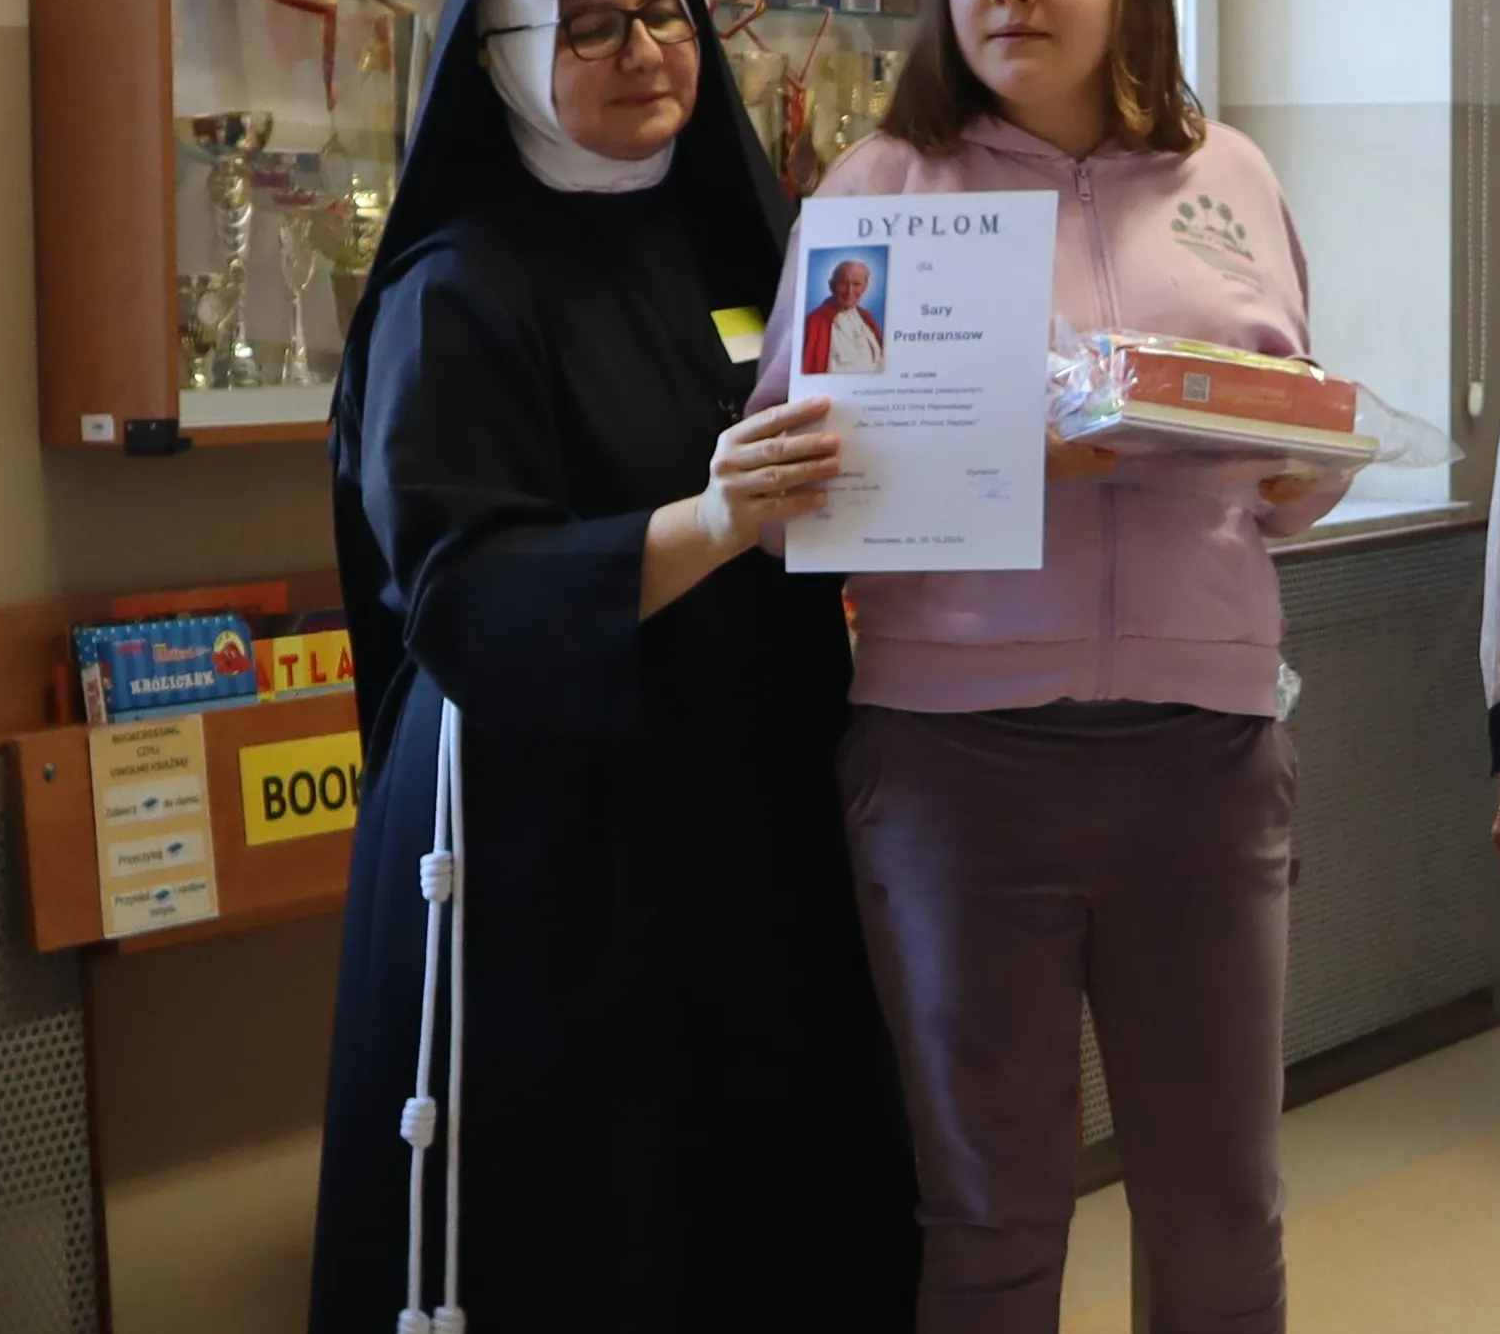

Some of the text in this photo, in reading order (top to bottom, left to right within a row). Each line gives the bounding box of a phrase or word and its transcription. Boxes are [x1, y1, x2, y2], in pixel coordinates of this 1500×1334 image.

[857, 212, 1001, 238] DYPLOM
[920, 304, 953, 317] Sary
[129, 670, 215, 695] KRÓLICZEK
